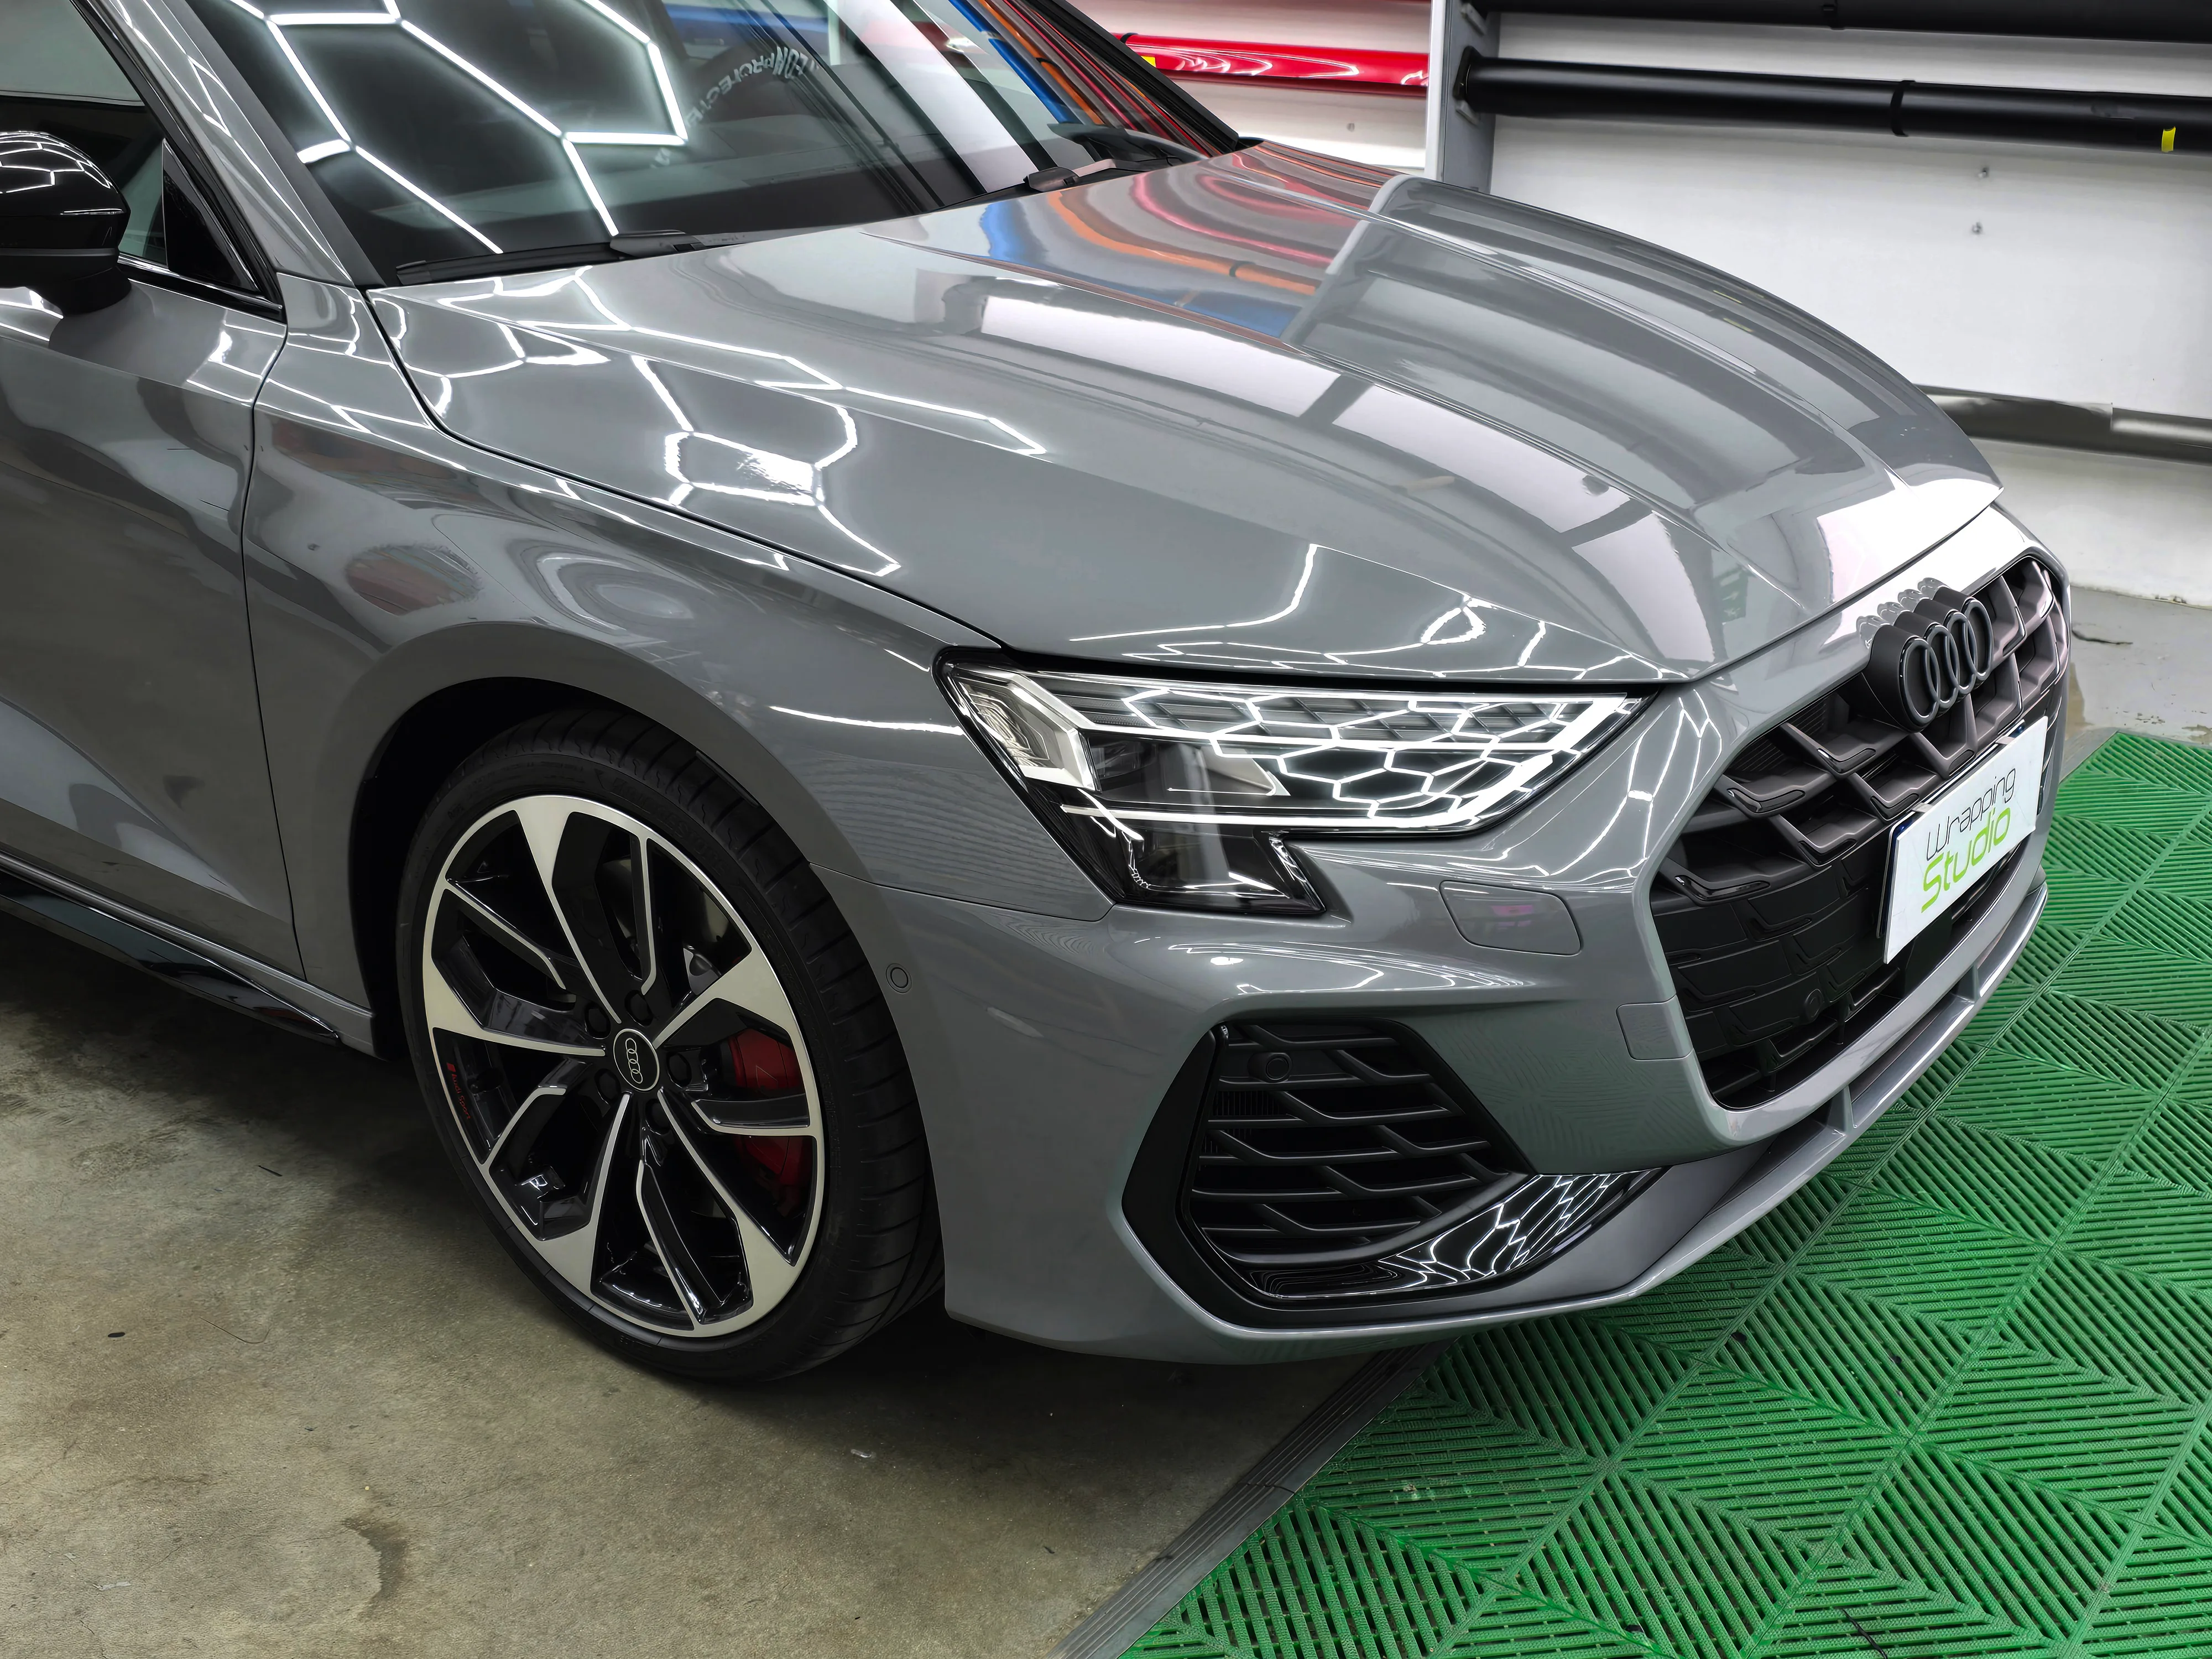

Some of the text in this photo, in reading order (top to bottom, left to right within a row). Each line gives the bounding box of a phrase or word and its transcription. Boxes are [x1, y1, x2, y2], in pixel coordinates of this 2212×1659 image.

[685, 53, 775, 128] PROTECTE
[451, 1073, 471, 1120] Audi Sport
